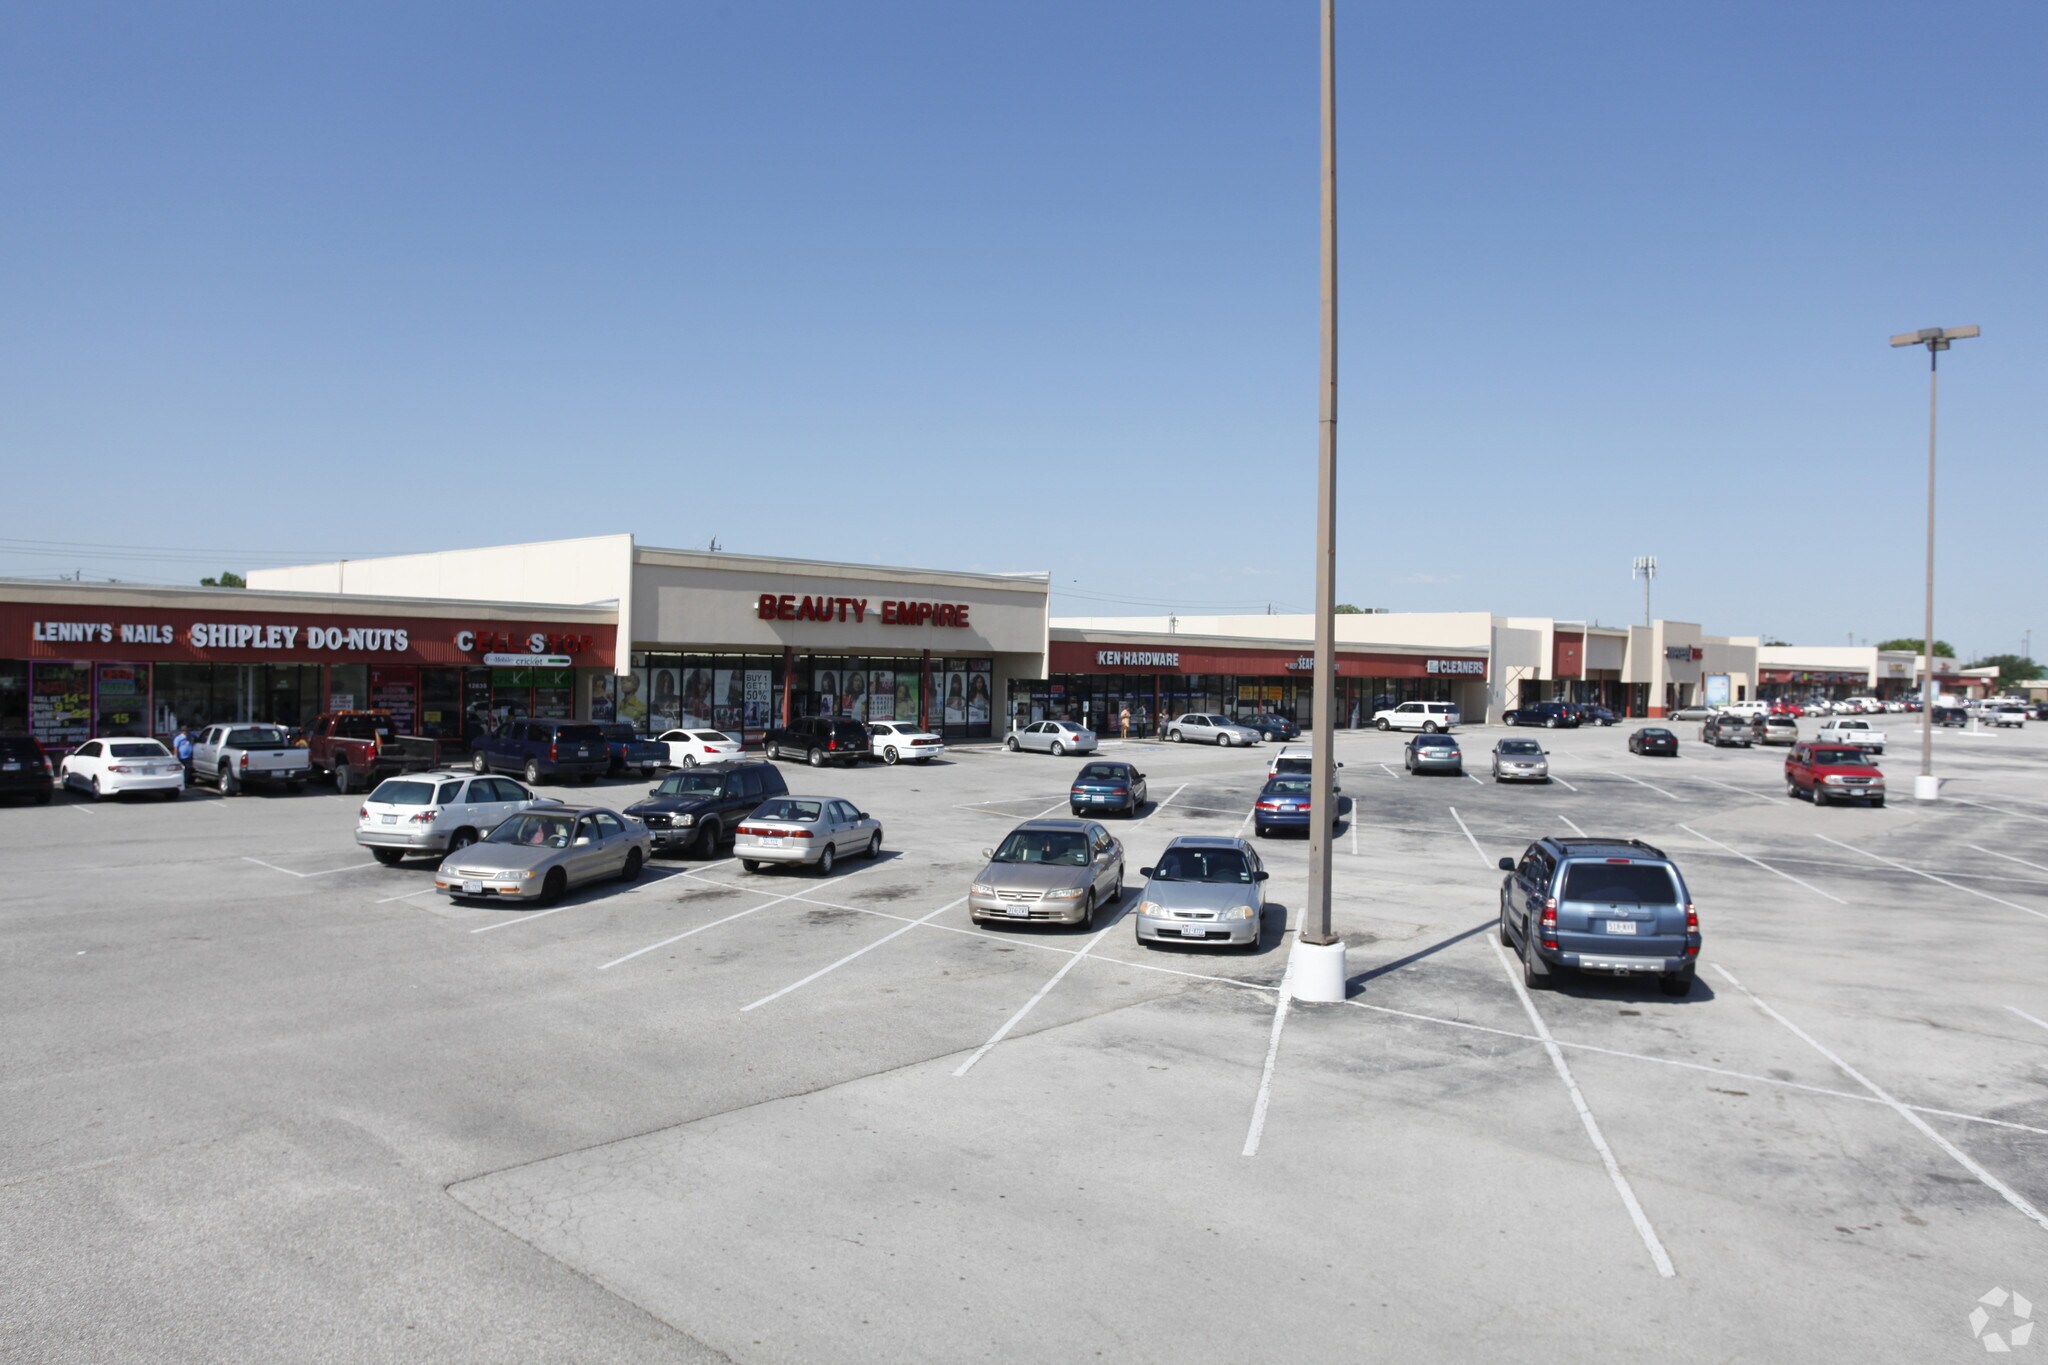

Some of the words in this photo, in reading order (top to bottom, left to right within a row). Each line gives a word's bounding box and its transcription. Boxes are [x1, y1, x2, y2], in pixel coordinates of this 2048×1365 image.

[758, 594, 868, 623] BEAUTY
[881, 600, 970, 628] EMPIRE
[34, 622, 112, 642] LENNY'S
[121, 624, 173, 644] NAILS
[191, 623, 298, 648] SHIPLEY
[307, 627, 408, 651] DO-NUTS
[457, 631, 521, 652] CELL
[515, 656, 543, 665] cricket
[1098, 651, 1121, 665] KEN
[1123, 651, 1179, 666] HARDWARE
[1440, 660, 1484, 673] CLEANERS
[746, 691, 767, 700] 50%
